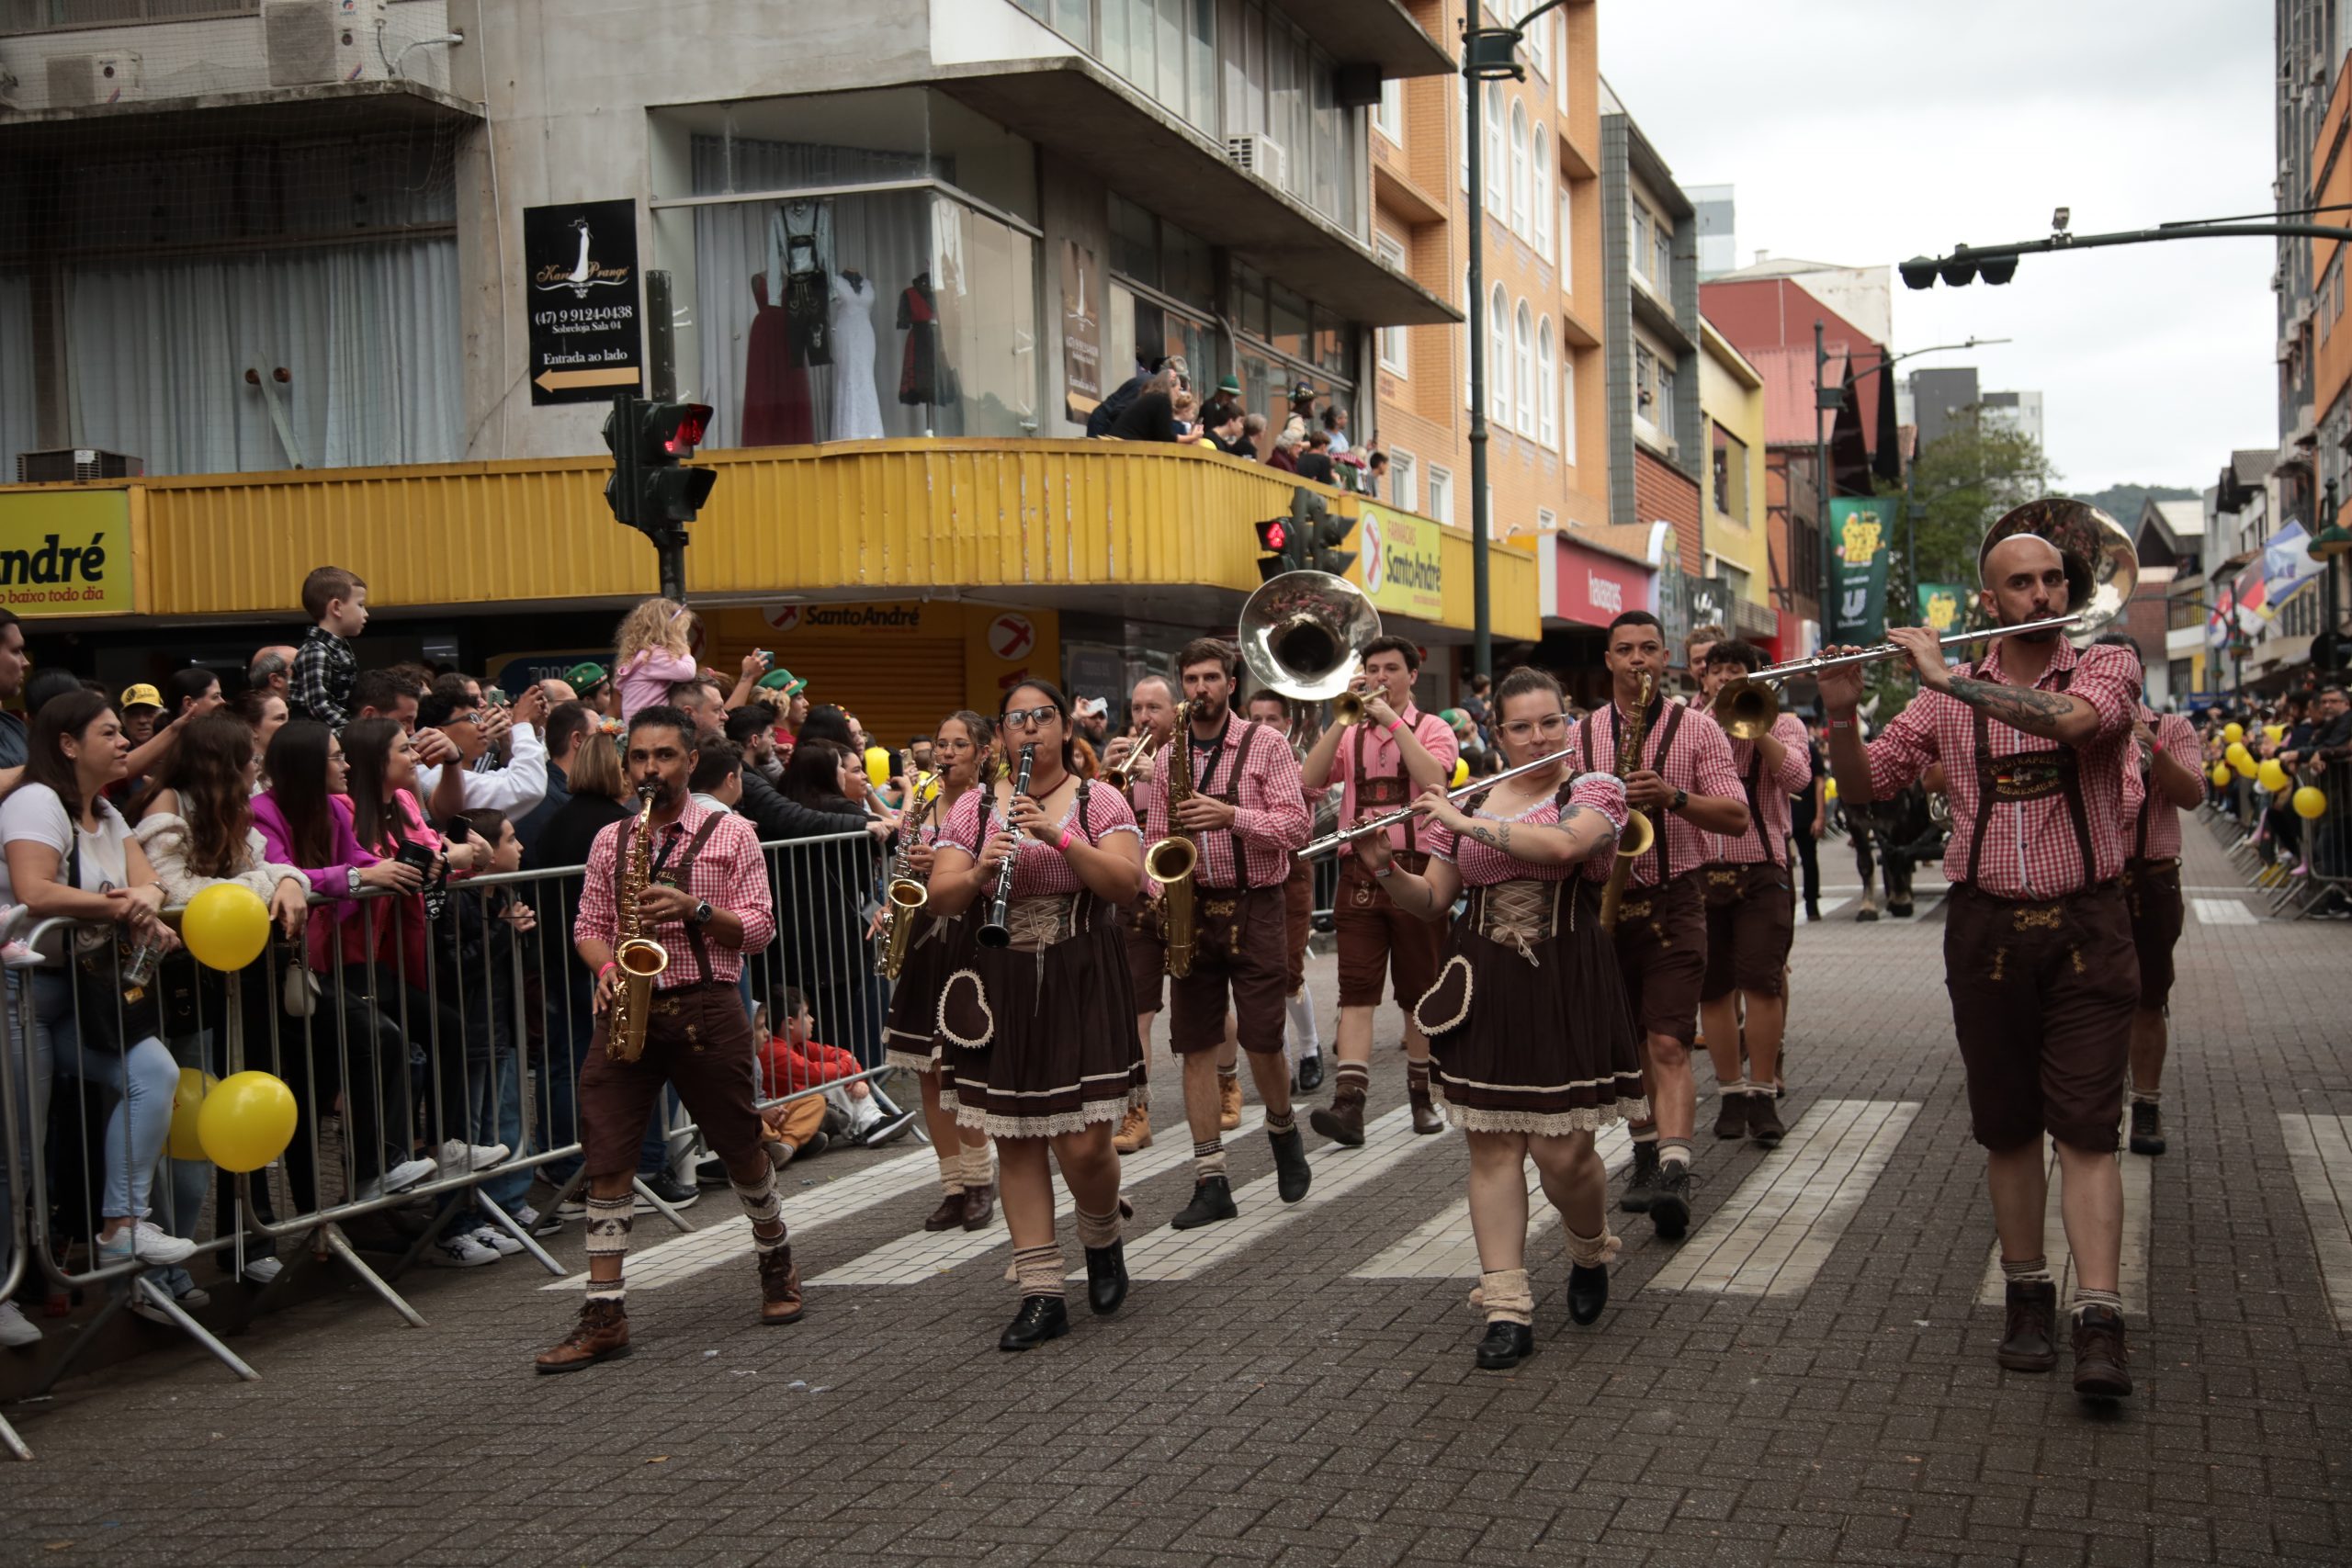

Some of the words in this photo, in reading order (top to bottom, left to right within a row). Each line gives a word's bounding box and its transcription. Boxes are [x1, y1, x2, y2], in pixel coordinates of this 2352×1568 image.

[535, 310, 557, 326] (47)
[560, 310, 569, 322] 9
[570, 305, 633, 321] 9124-0438
[551, 322, 590, 334] Sobreloja
[592, 321, 609, 332] Sala
[610, 321, 621, 330] 04
[543, 350, 586, 366] Entrada
[588, 353, 602, 362] ao
[604, 348, 628, 361] lado
[0, 532, 105, 585] ndré
[8, 589, 46, 604] baixo
[49, 587, 79, 602] todo
[82, 586, 104, 601] dia
